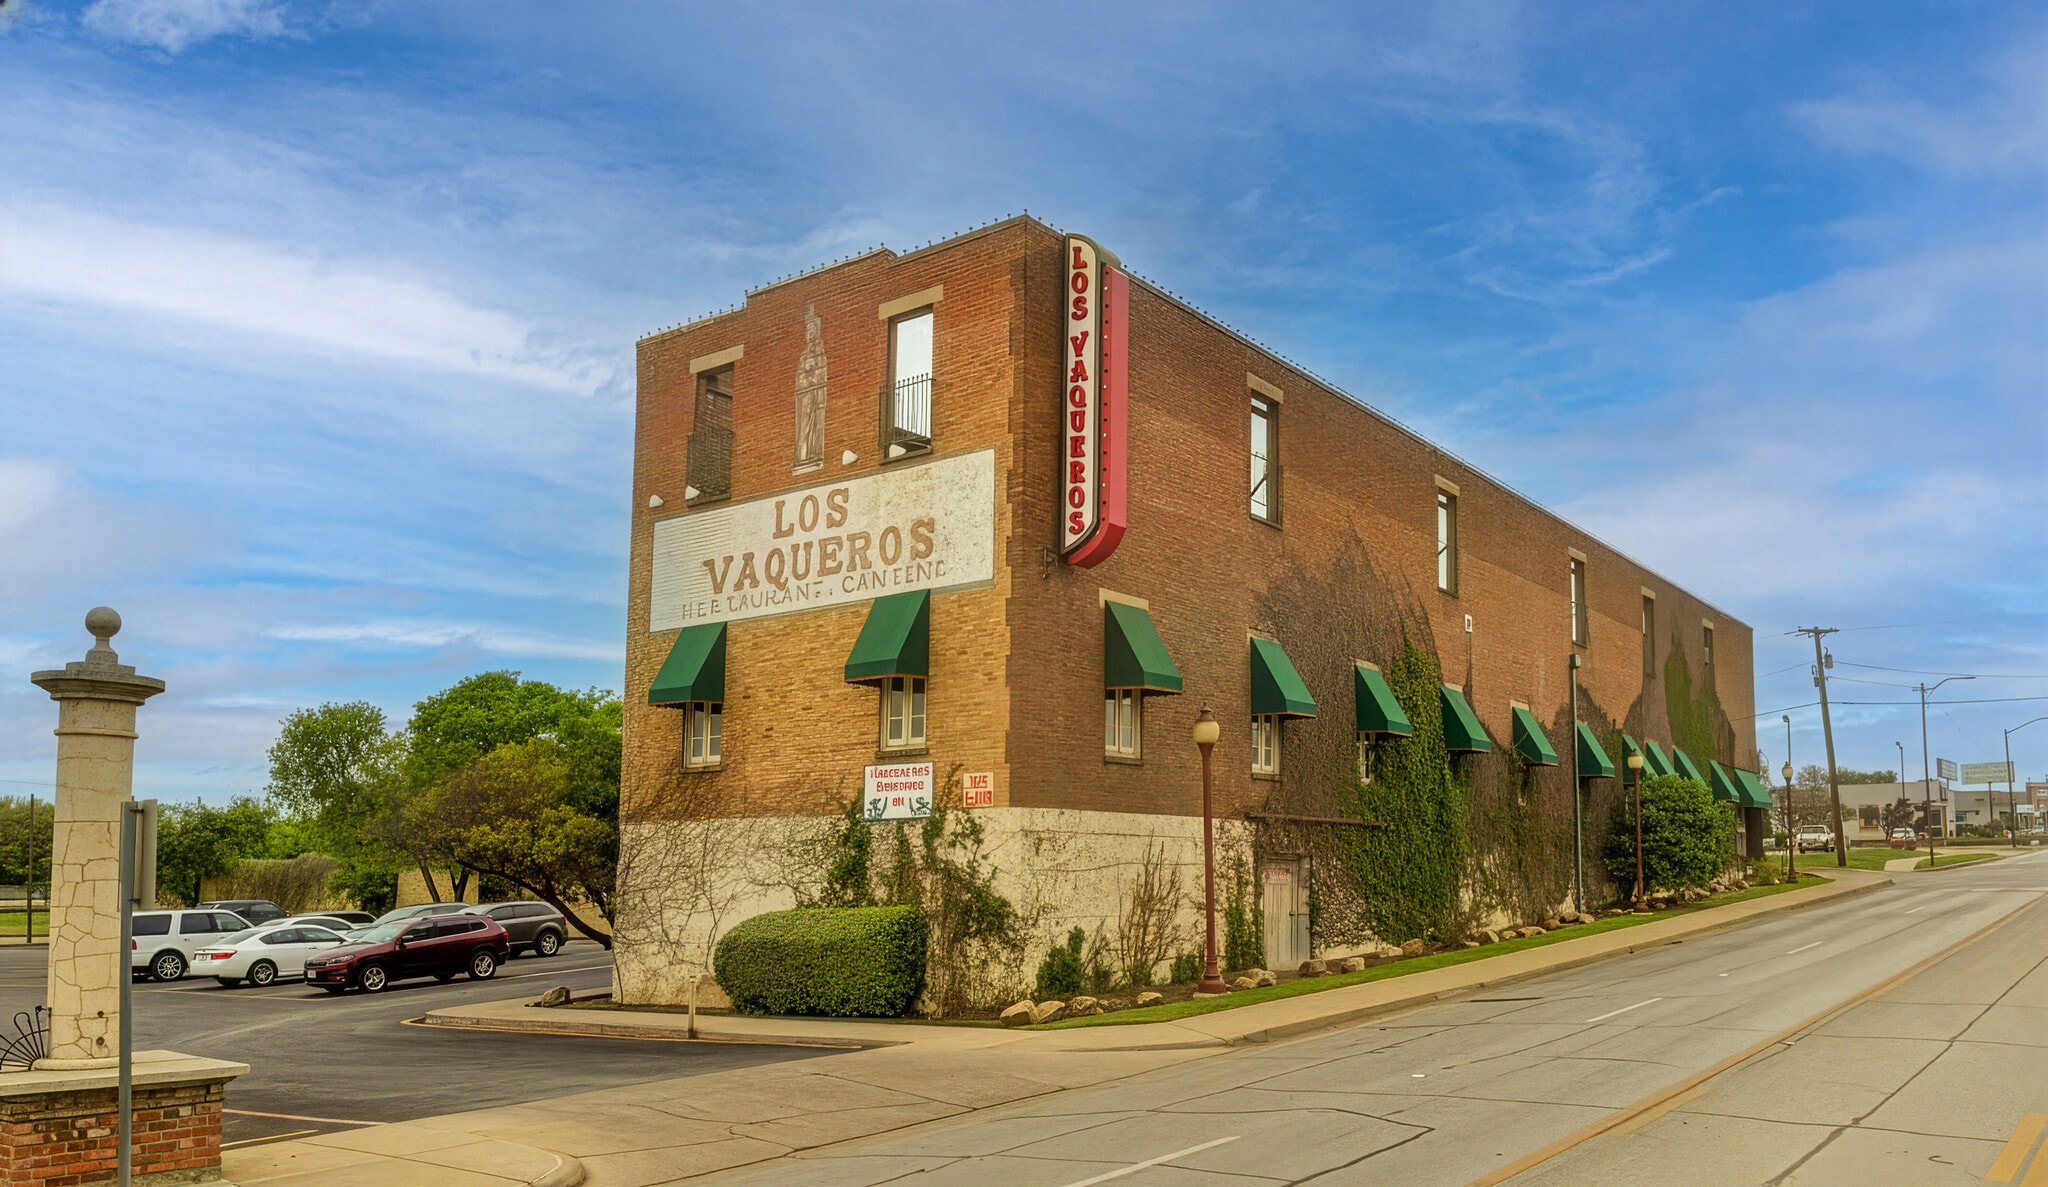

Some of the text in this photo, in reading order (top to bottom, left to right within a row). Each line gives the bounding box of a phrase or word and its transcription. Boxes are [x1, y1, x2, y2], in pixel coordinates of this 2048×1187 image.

[1068, 246, 1089, 535] LOS VAQUEROS
[773, 488, 849, 539] LOS
[703, 517, 935, 595] VAQUEROS
